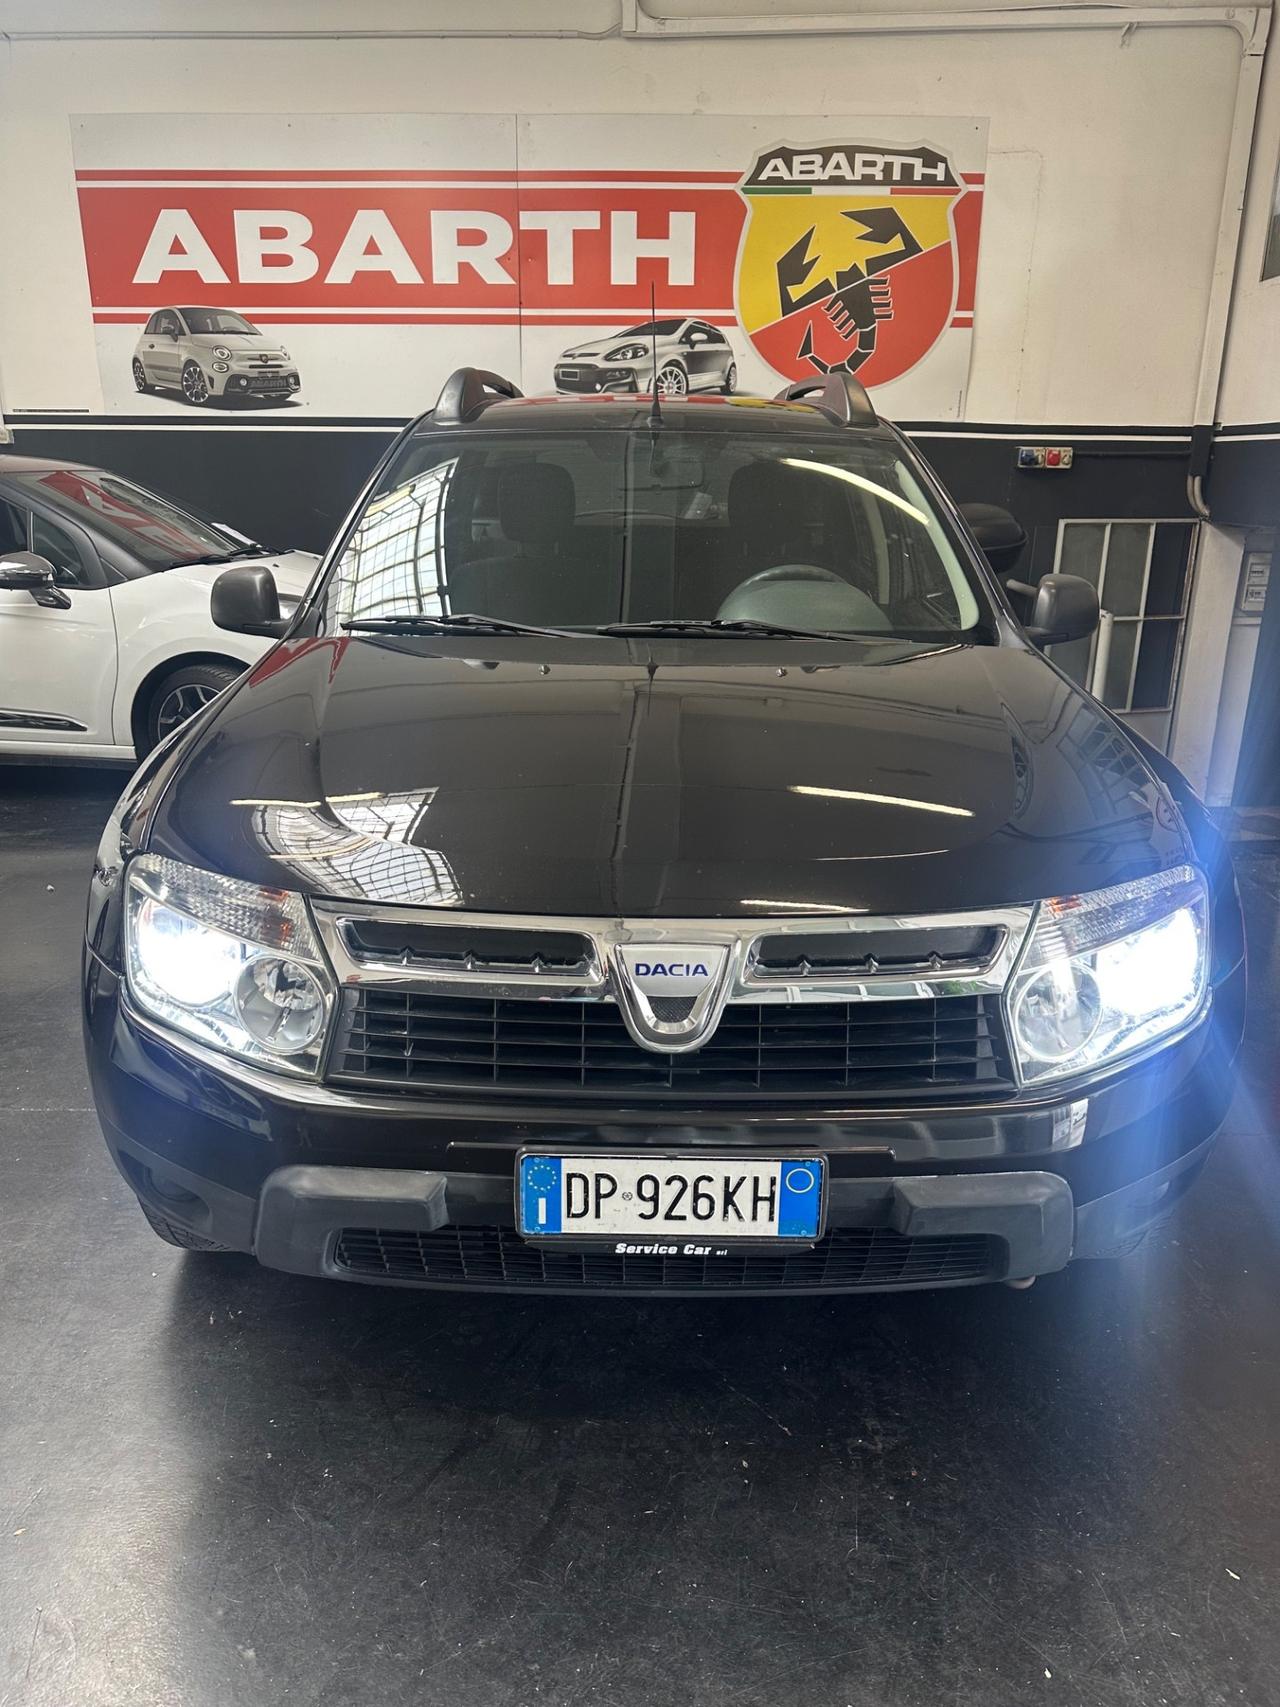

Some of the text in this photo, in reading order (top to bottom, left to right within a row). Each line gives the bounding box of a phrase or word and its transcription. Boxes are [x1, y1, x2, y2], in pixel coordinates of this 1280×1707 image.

[757, 152, 946, 182] ABARTH
[132, 209, 696, 285] ABARTH
[635, 963, 708, 976] DACIA
[566, 1172, 617, 1219] DP
[636, 1174, 776, 1222] 926KH
[615, 1243, 678, 1255] Service
[683, 1244, 712, 1255] Car
